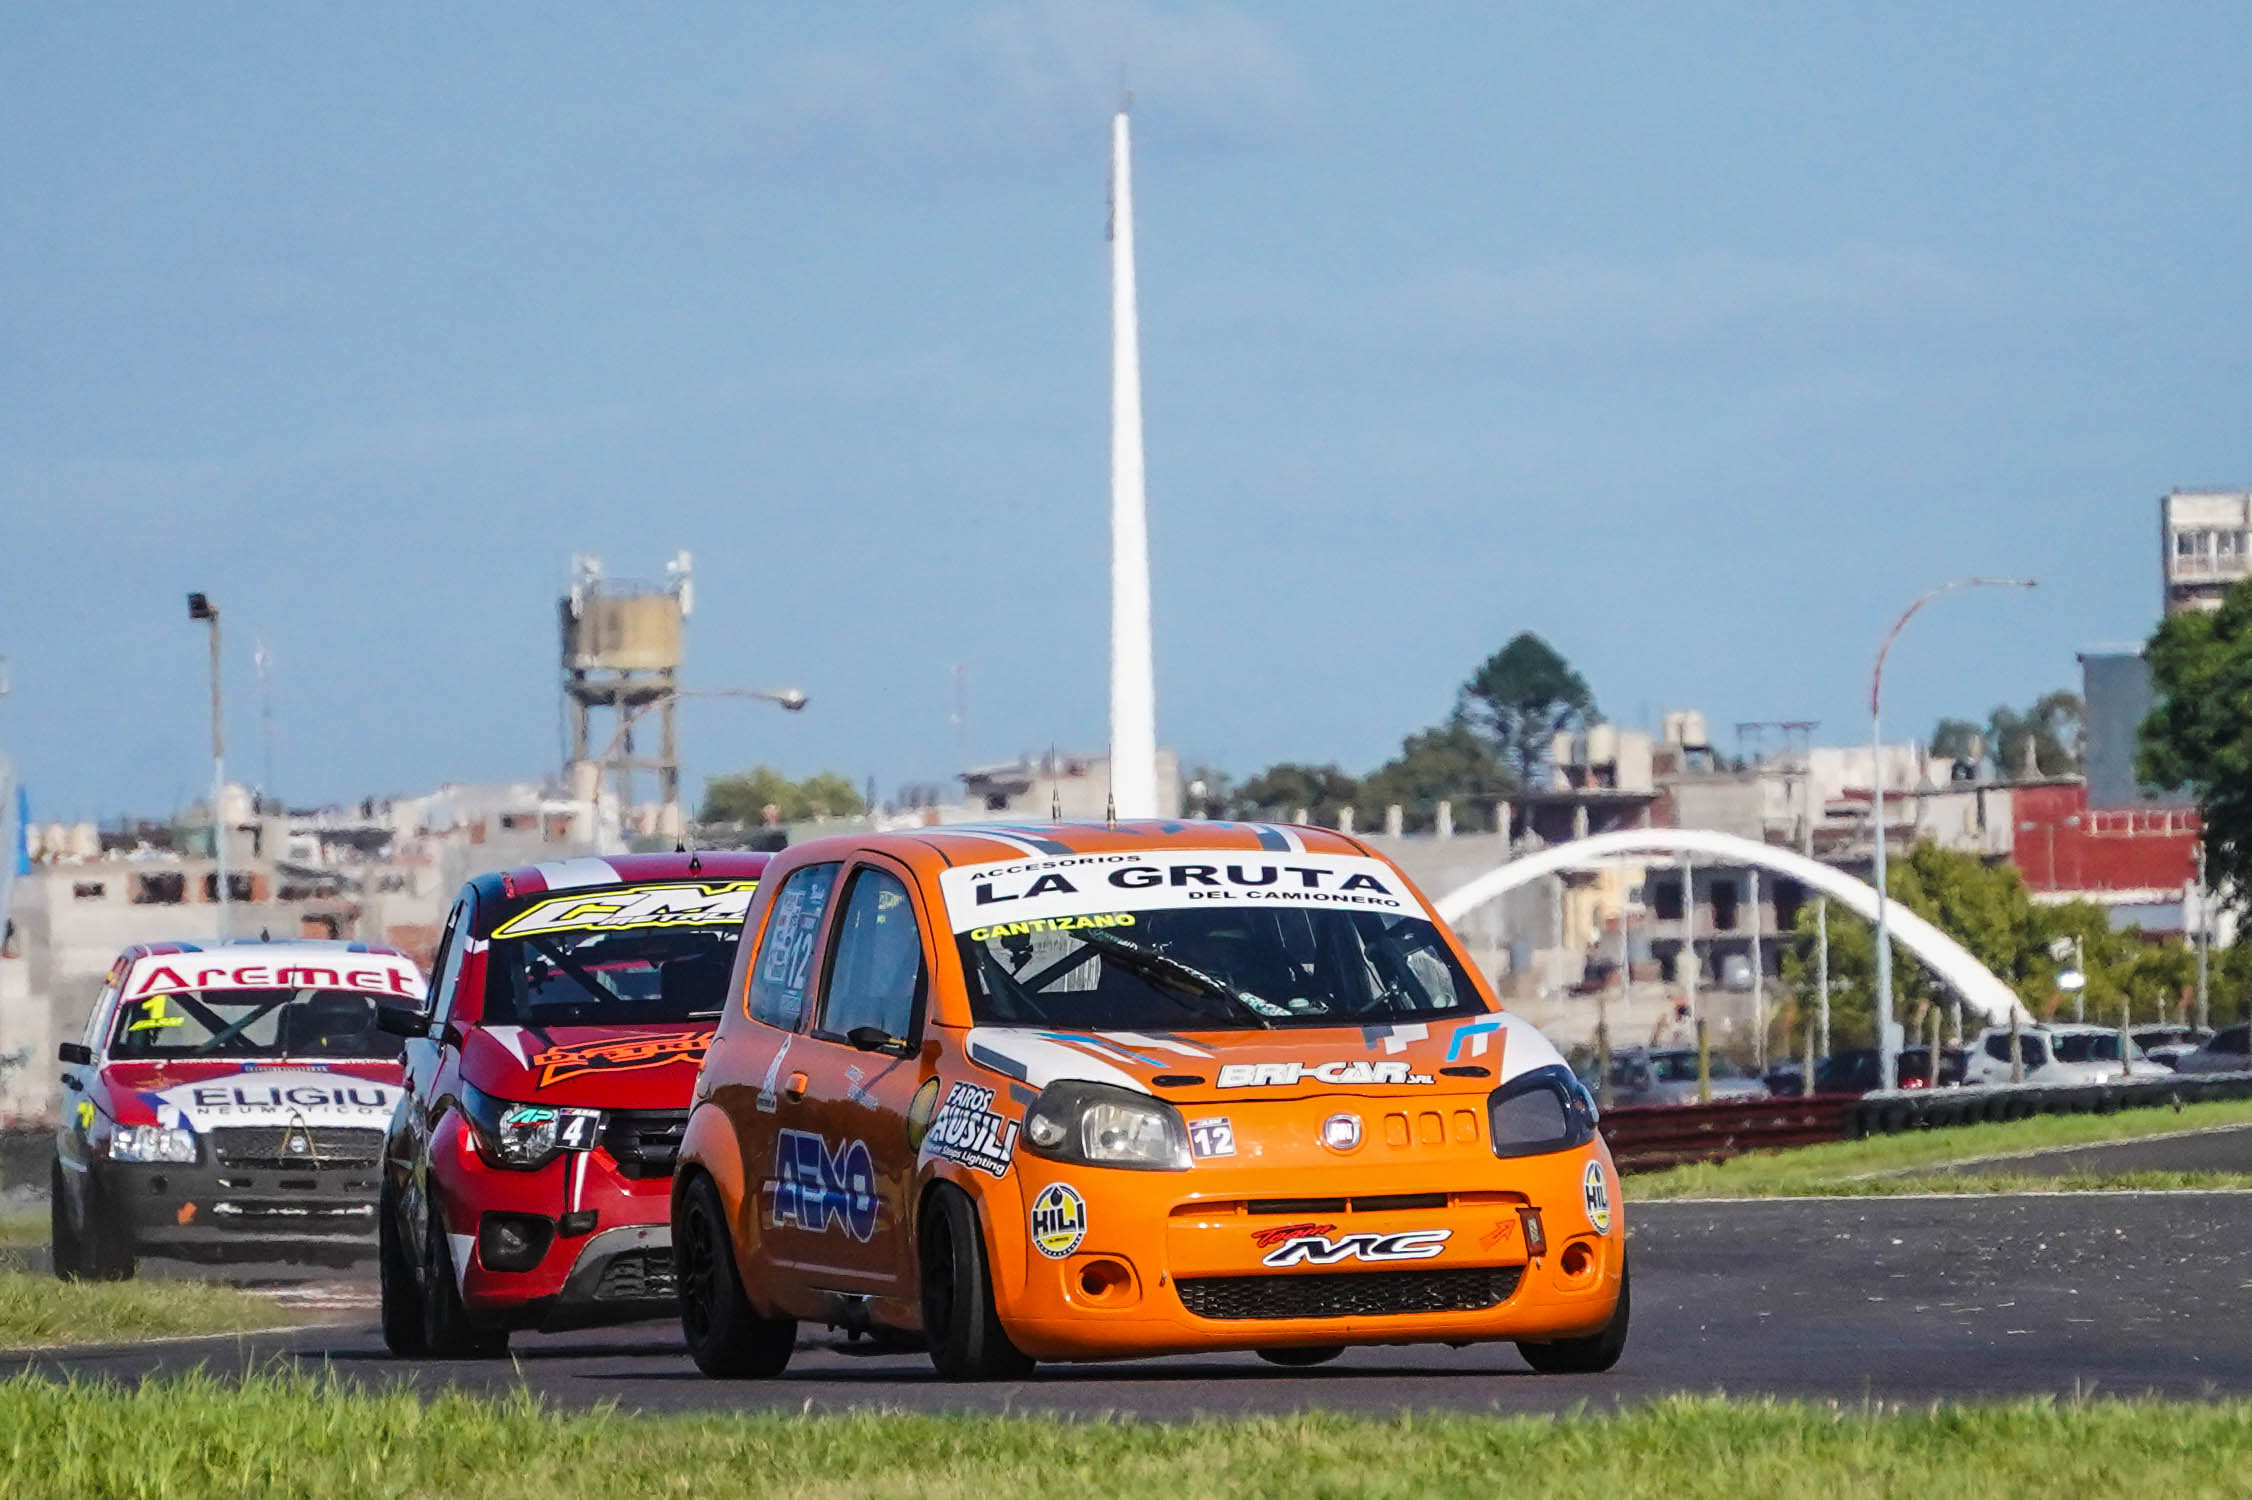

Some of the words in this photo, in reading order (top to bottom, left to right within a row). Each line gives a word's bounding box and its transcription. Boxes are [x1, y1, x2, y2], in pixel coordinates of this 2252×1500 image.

[970, 854, 1142, 881] ACCESORIOS
[975, 873, 1078, 907] LA
[1108, 864, 1394, 896] GRUTA
[1188, 890, 1236, 901] DEL
[1246, 890, 1401, 908] CAMIONERO
[970, 912, 1137, 943] CANTIZANO
[141, 994, 167, 1020] 1
[1216, 1061, 1412, 1089] BRI-CAR
[192, 1087, 387, 1107] ELIGIU
[196, 1106, 394, 1116] NEUMATICOS
[945, 1083, 994, 1112] FAROS
[562, 1116, 586, 1147] 4
[929, 1104, 1019, 1162] AUSILI
[1193, 1126, 1235, 1156] 12
[961, 1151, 1006, 1175] Lighting
[1032, 1202, 1086, 1239] HILI
